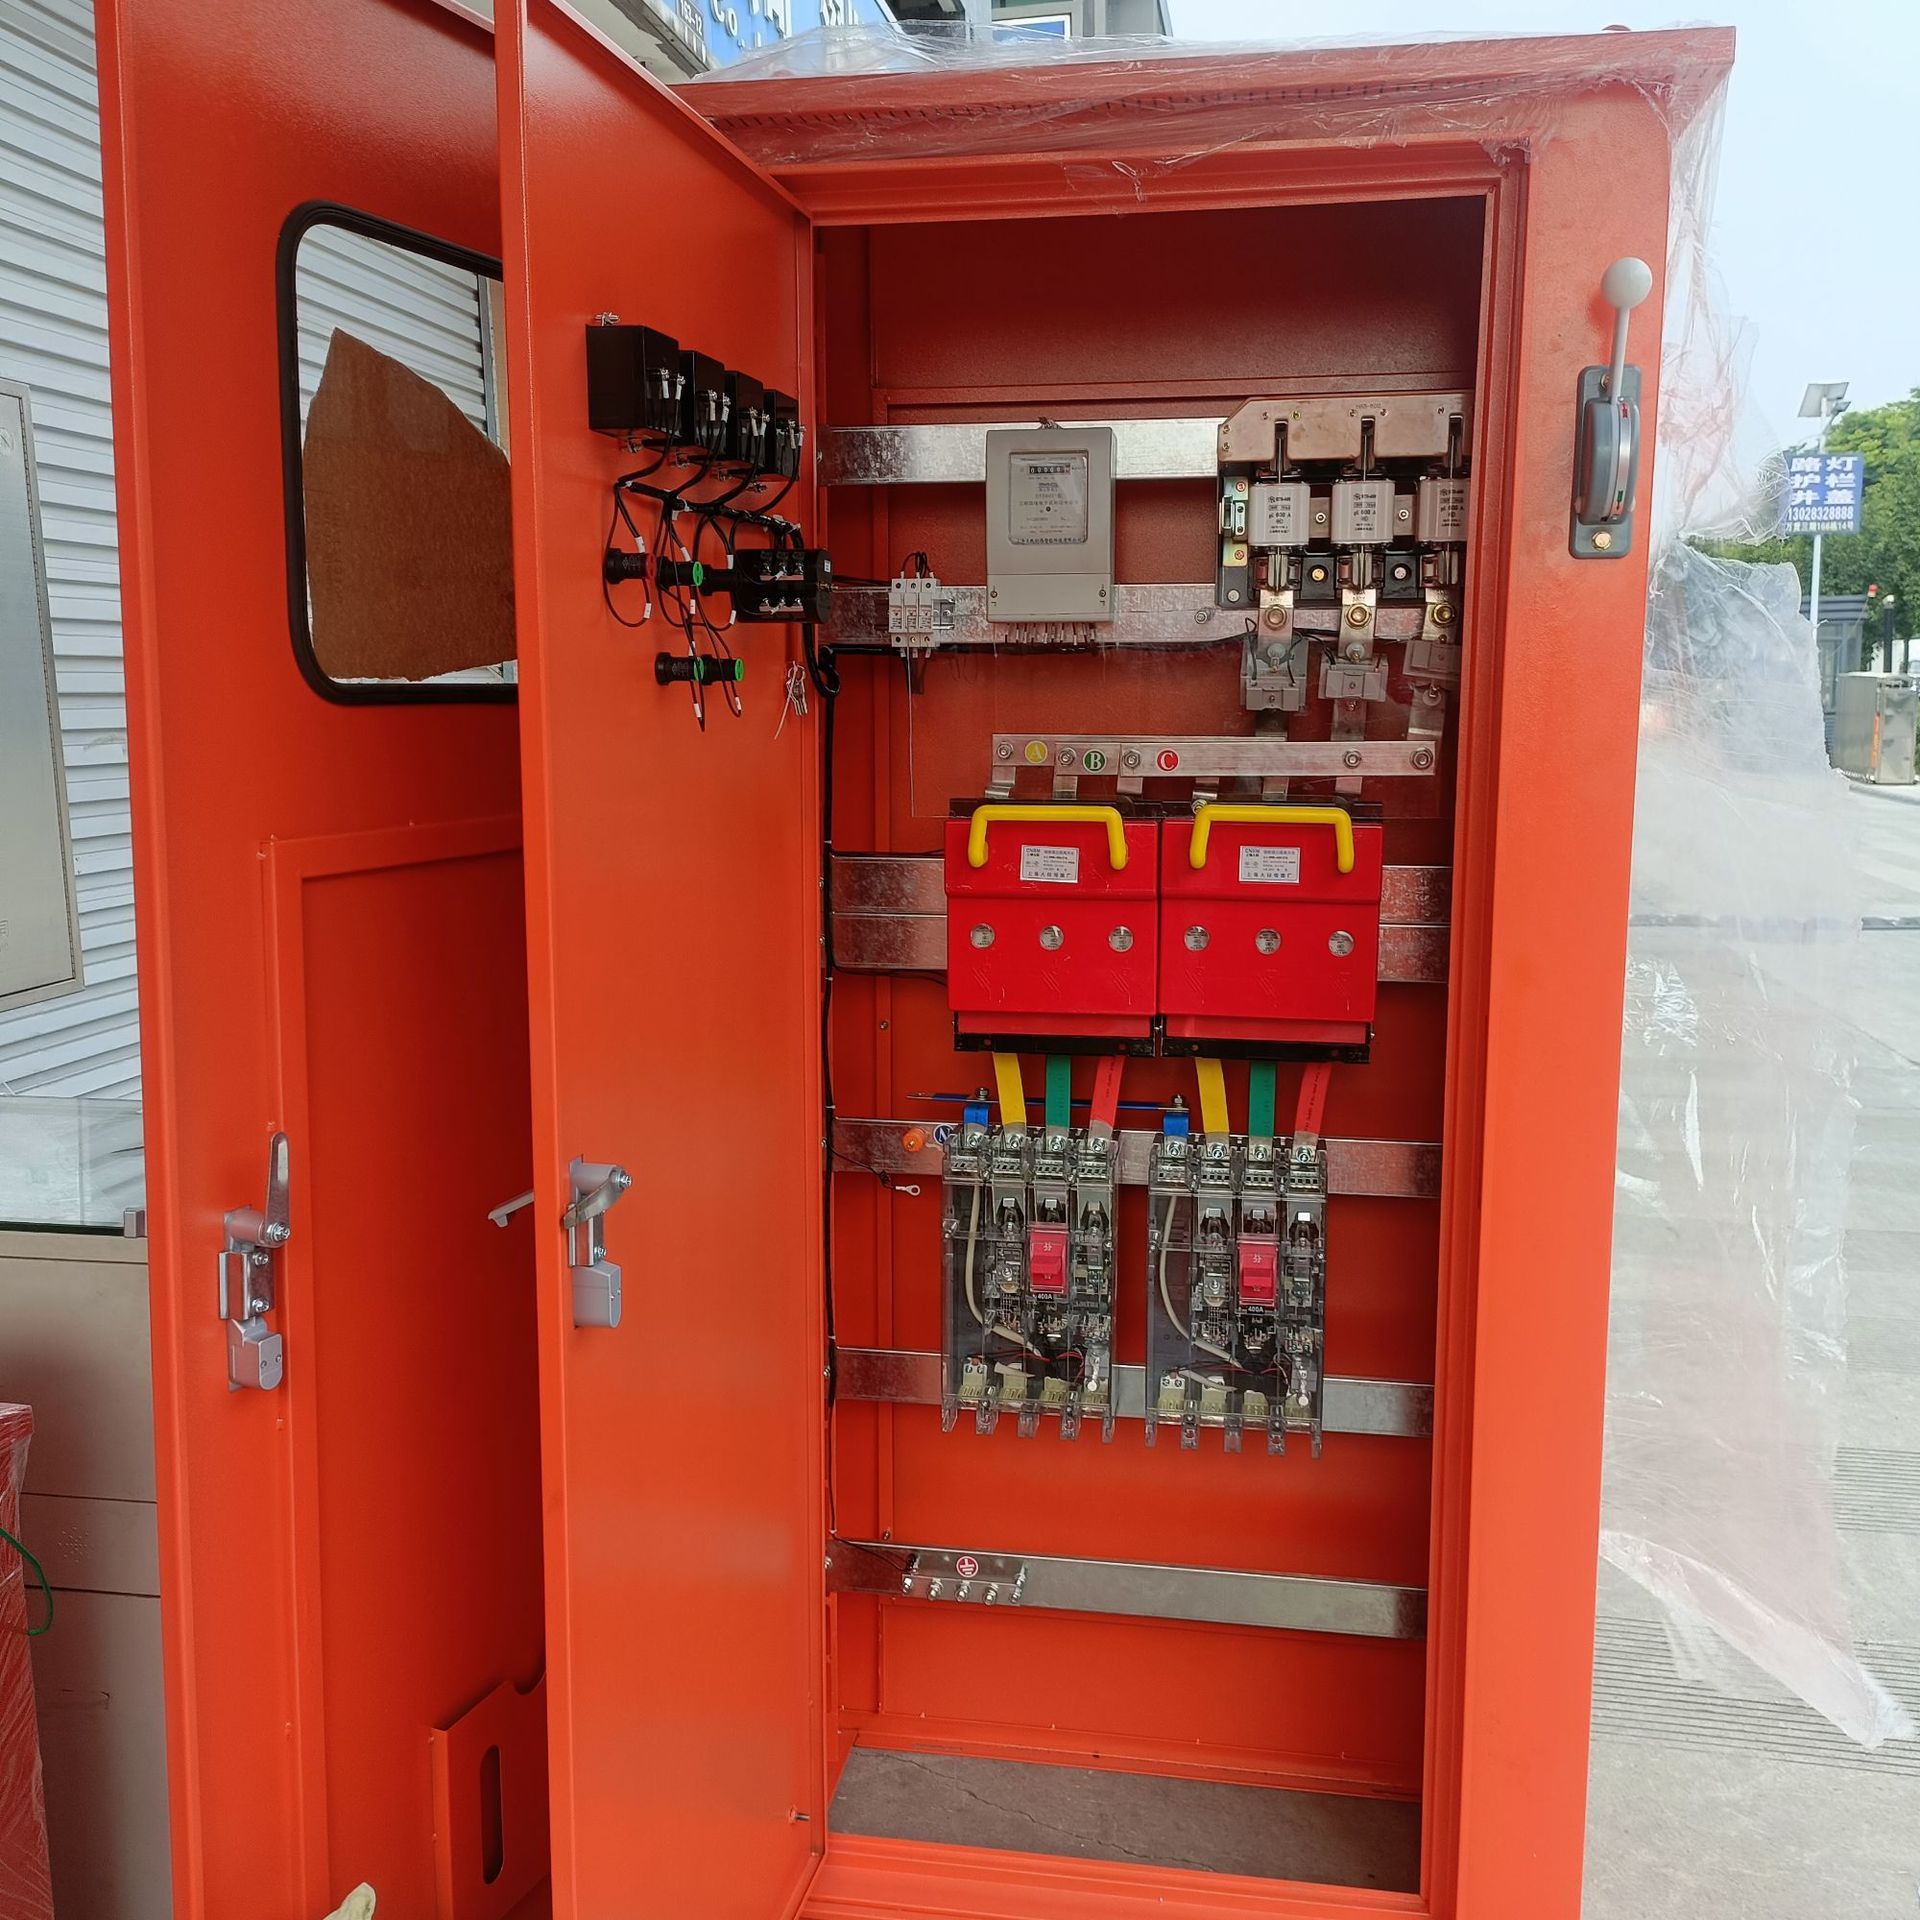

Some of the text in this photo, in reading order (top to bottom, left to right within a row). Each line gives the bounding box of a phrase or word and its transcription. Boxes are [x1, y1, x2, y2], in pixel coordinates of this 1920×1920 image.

[1790, 456, 1858, 472] 路灯
[1790, 473, 1856, 488] 护栏
[1790, 489, 1855, 505] 井盖
[1788, 506, 1854, 521] 13028328888
[1031, 742, 1043, 762] A
[1089, 752, 1102, 770] B
[1160, 752, 1175, 771] C
